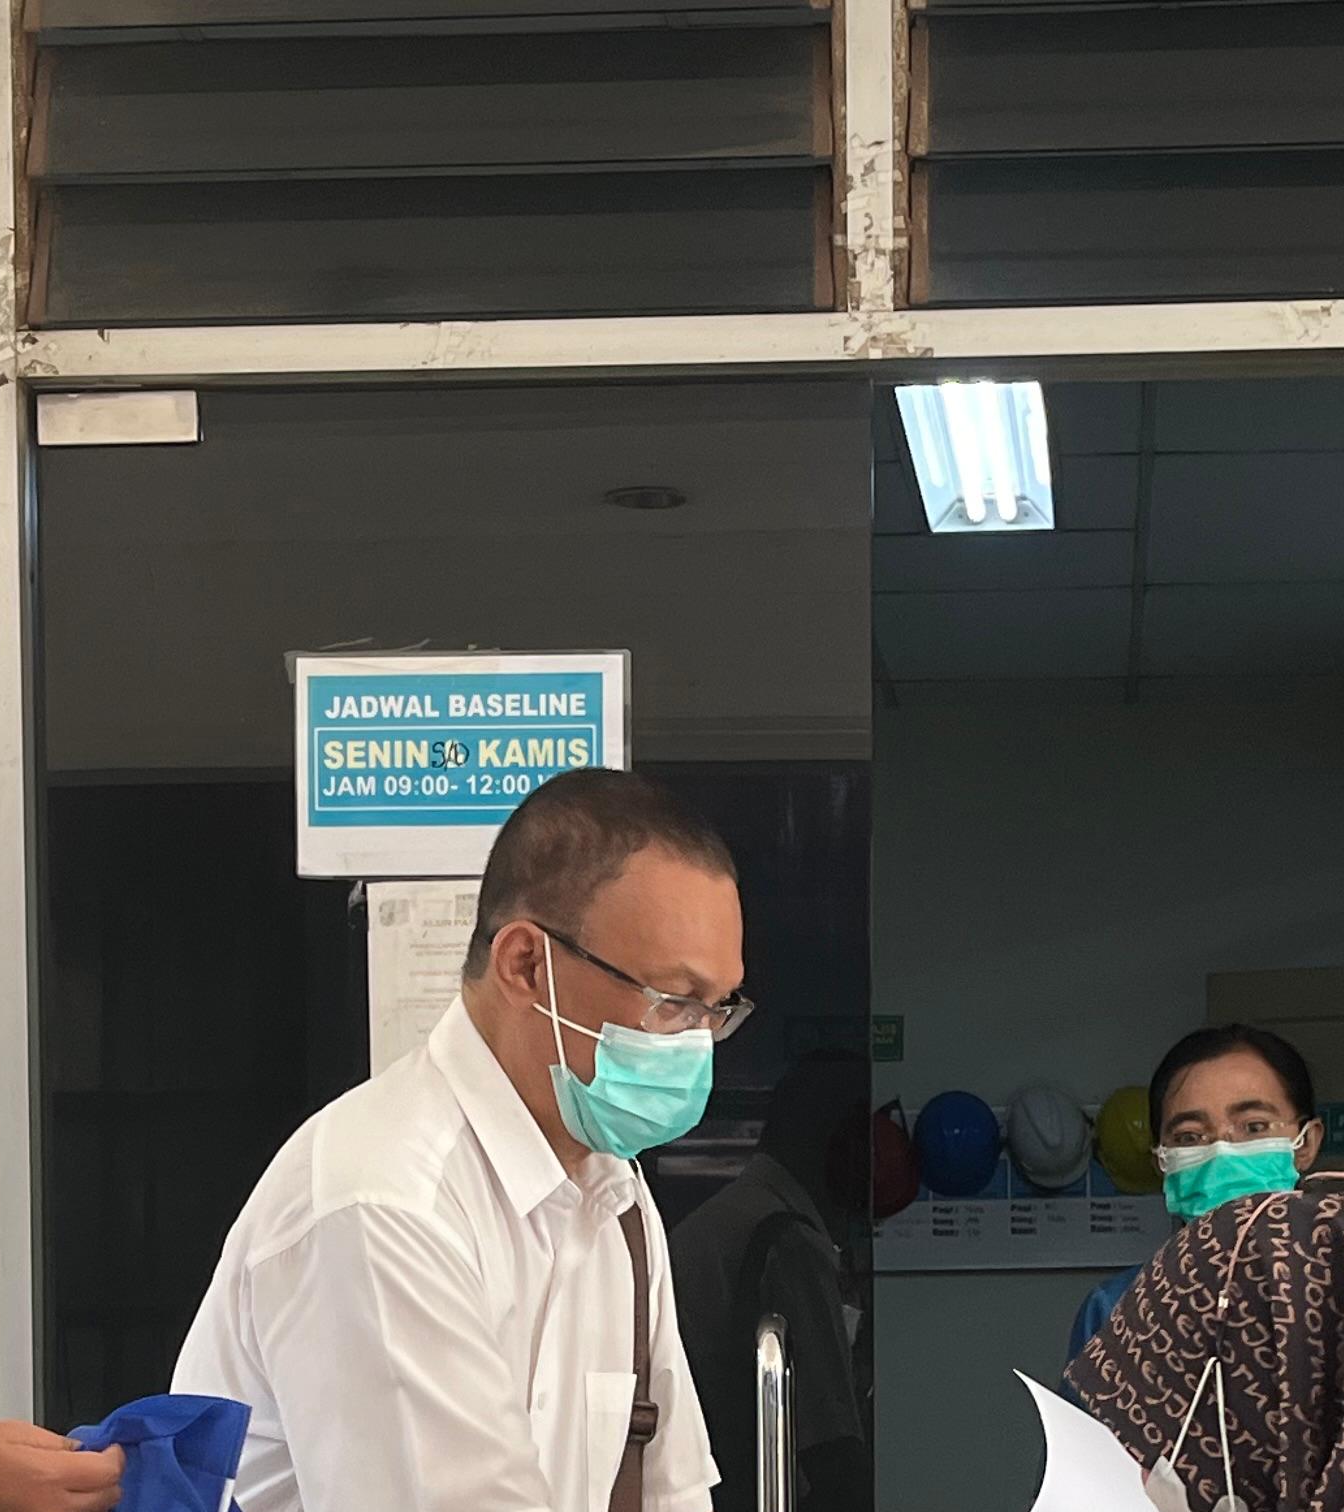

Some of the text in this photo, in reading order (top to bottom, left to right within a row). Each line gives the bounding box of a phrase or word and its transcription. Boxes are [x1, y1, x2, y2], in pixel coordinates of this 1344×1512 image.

[324, 693, 587, 719] JADWAL BASELINE
[323, 740, 429, 769] SENIN
[478, 738, 590, 768] KAMIS
[322, 776, 377, 797] JAM
[465, 774, 531, 795] 12:00
